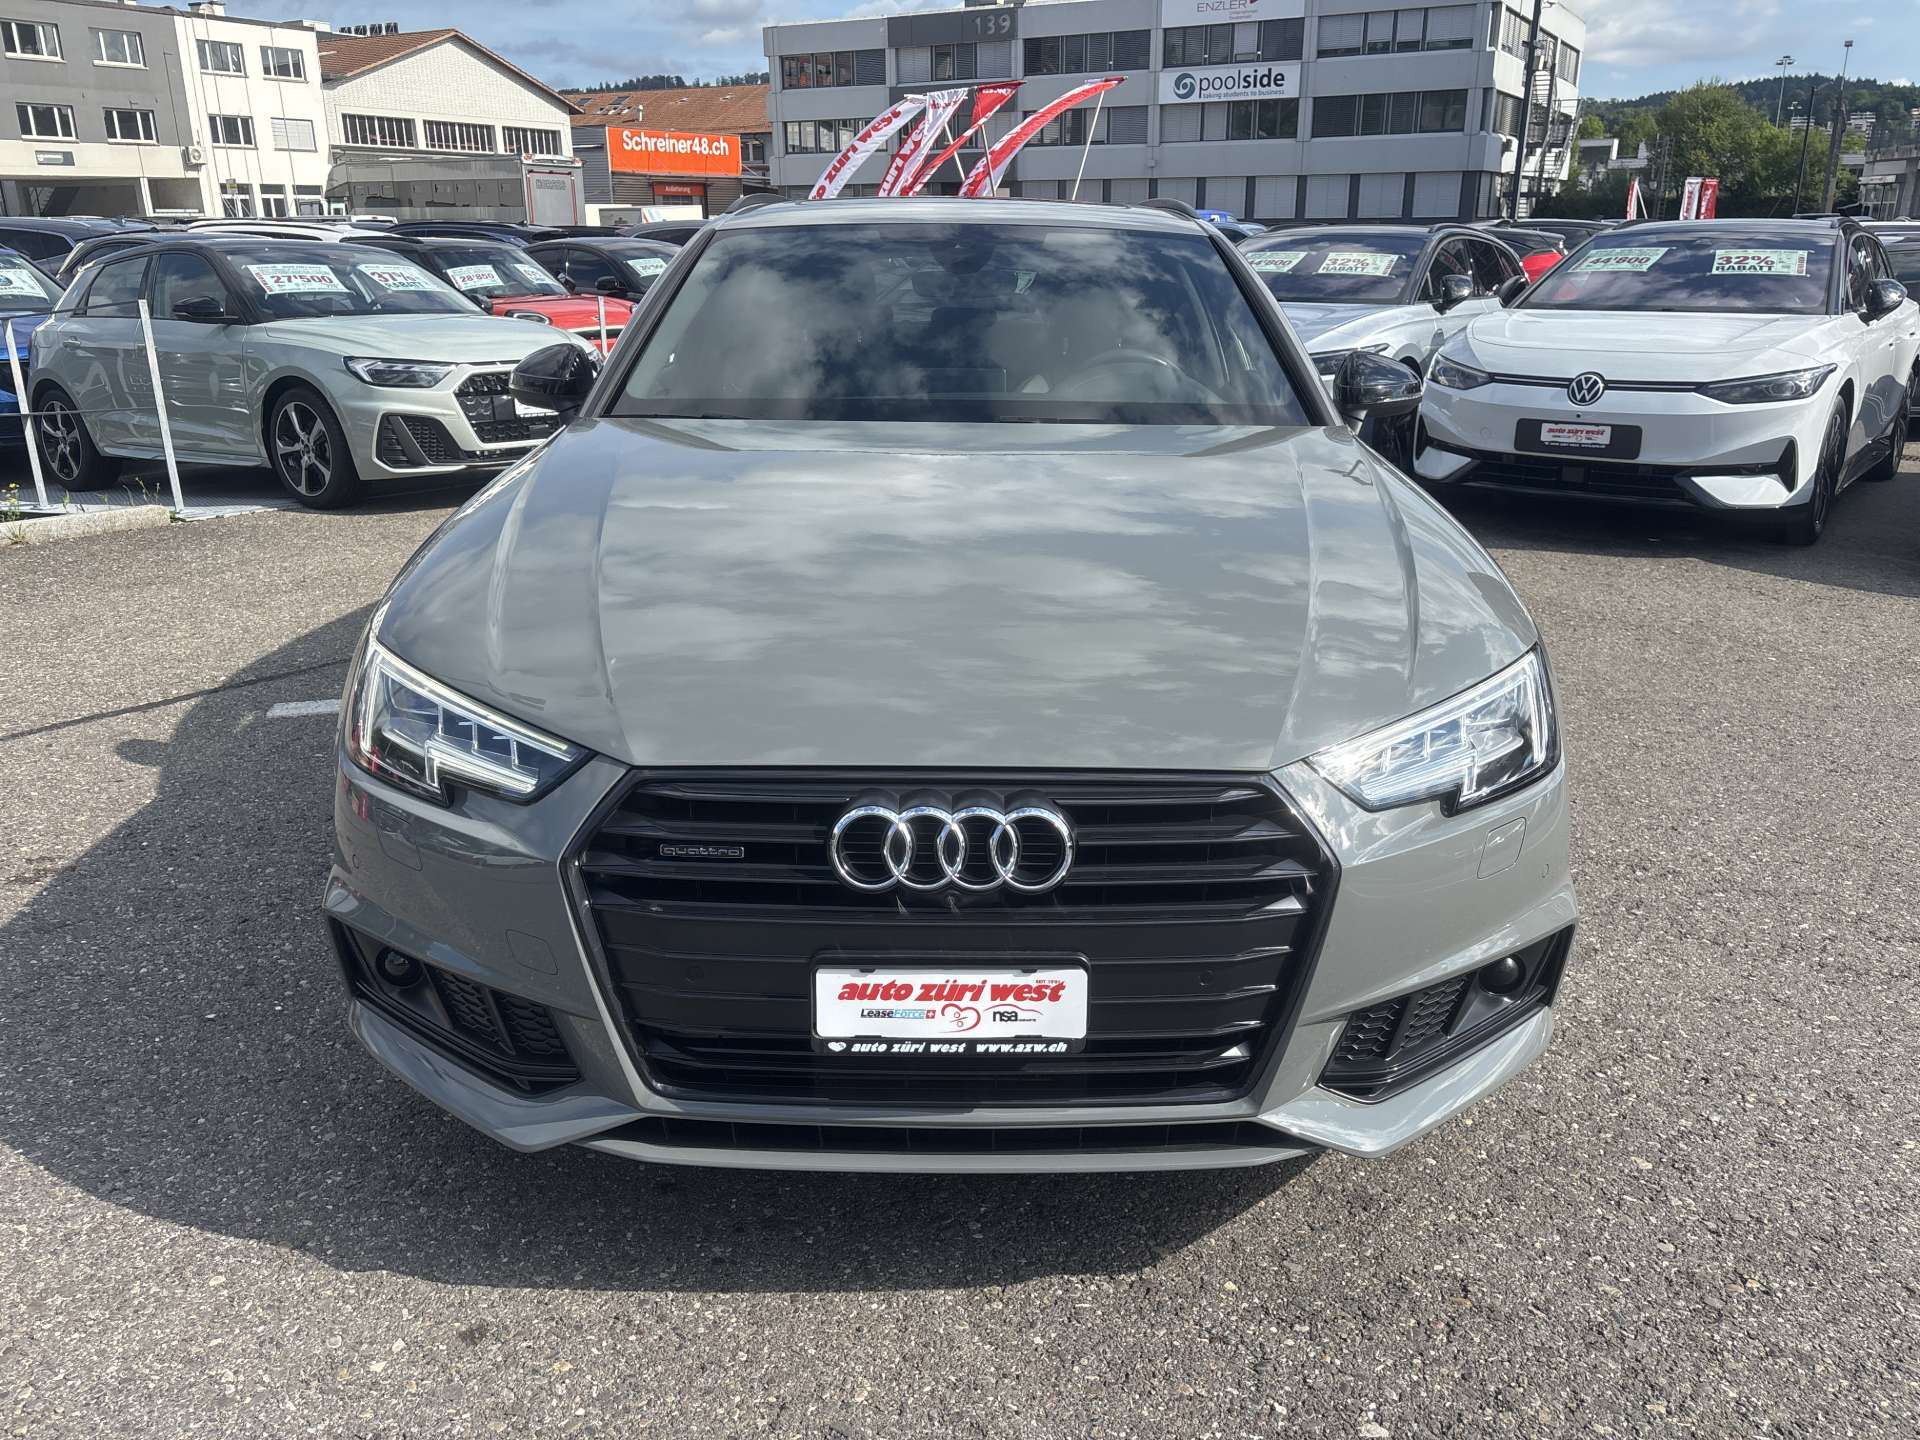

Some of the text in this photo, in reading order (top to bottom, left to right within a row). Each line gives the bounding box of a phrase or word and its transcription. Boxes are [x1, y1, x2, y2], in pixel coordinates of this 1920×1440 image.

[1197, 0, 1247, 12] ENZLER
[974, 14, 1011, 35] 139
[1199, 67, 1286, 99] poolside
[1223, 90, 1249, 98] students
[857, 107, 902, 143] west
[622, 129, 729, 156] Schreiner48.ch
[1325, 257, 1370, 267] 32%
[1716, 255, 1776, 266] 32%
[1321, 265, 1367, 273] RABATT
[271, 274, 334, 284] 27'500
[662, 846, 740, 856] quattro
[837, 979, 1066, 1002] auto züri west
[860, 1008, 925, 1019] LeaseForce
[992, 1010, 1018, 1022] nsa
[850, 1041, 1068, 1053] auto züri west www.azw.ch
